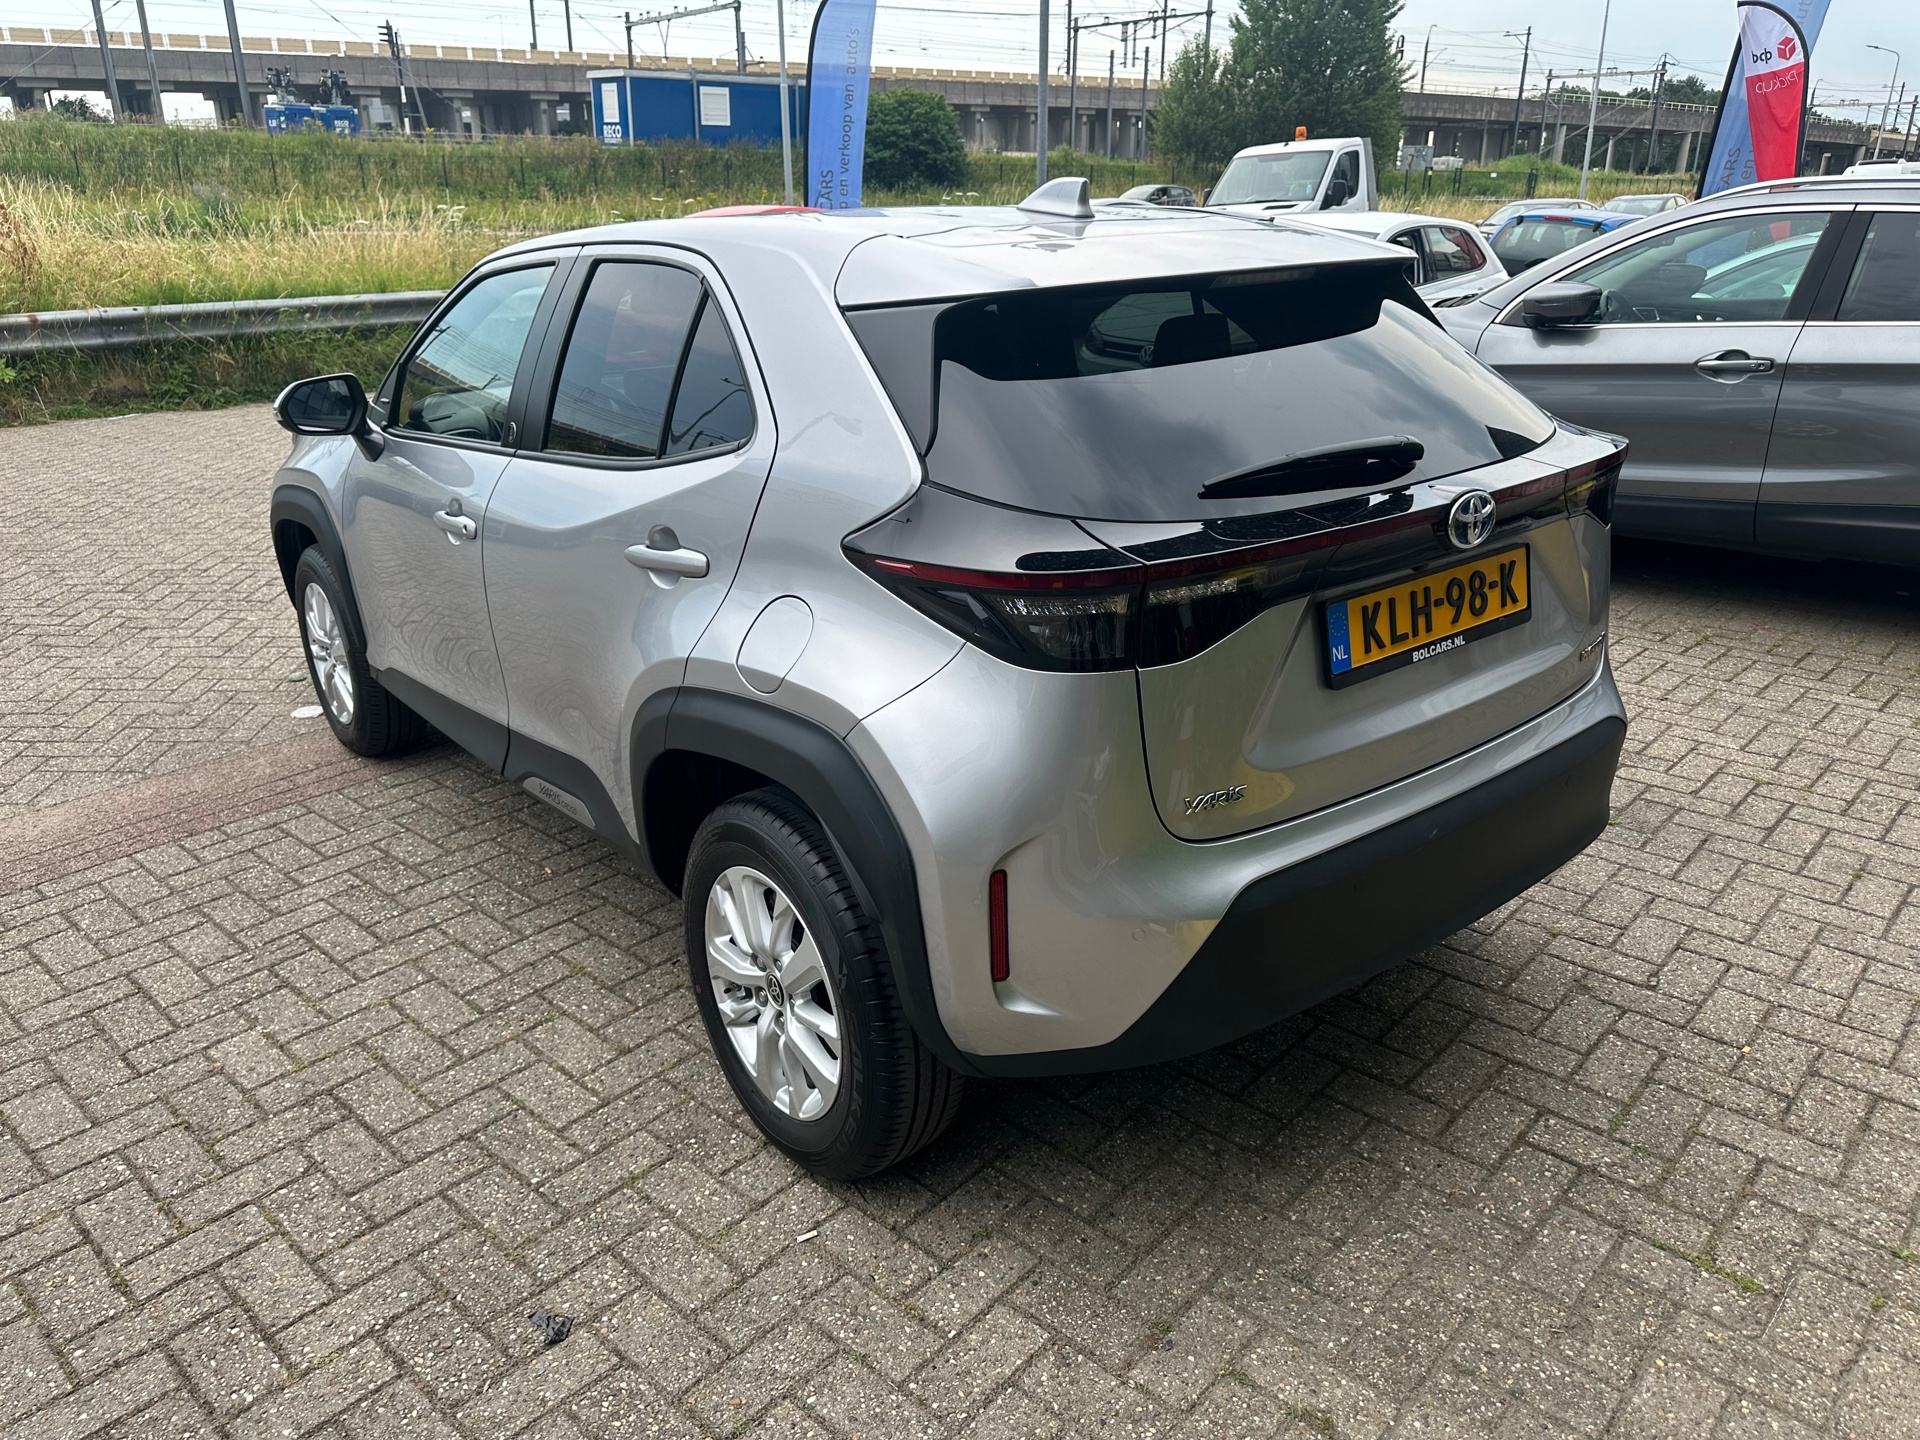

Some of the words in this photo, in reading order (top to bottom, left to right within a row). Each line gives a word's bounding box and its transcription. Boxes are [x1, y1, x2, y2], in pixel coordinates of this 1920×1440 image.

[843, 83, 855, 113] van
[603, 124, 622, 138] RECO
[838, 114, 855, 174] verkoop
[1715, 147, 1741, 191] ARS
[839, 179, 849, 197] en
[1361, 559, 1520, 655] KLH-98-K
[1332, 644, 1349, 662] NL
[1412, 634, 1466, 663] BOLCARS.NL
